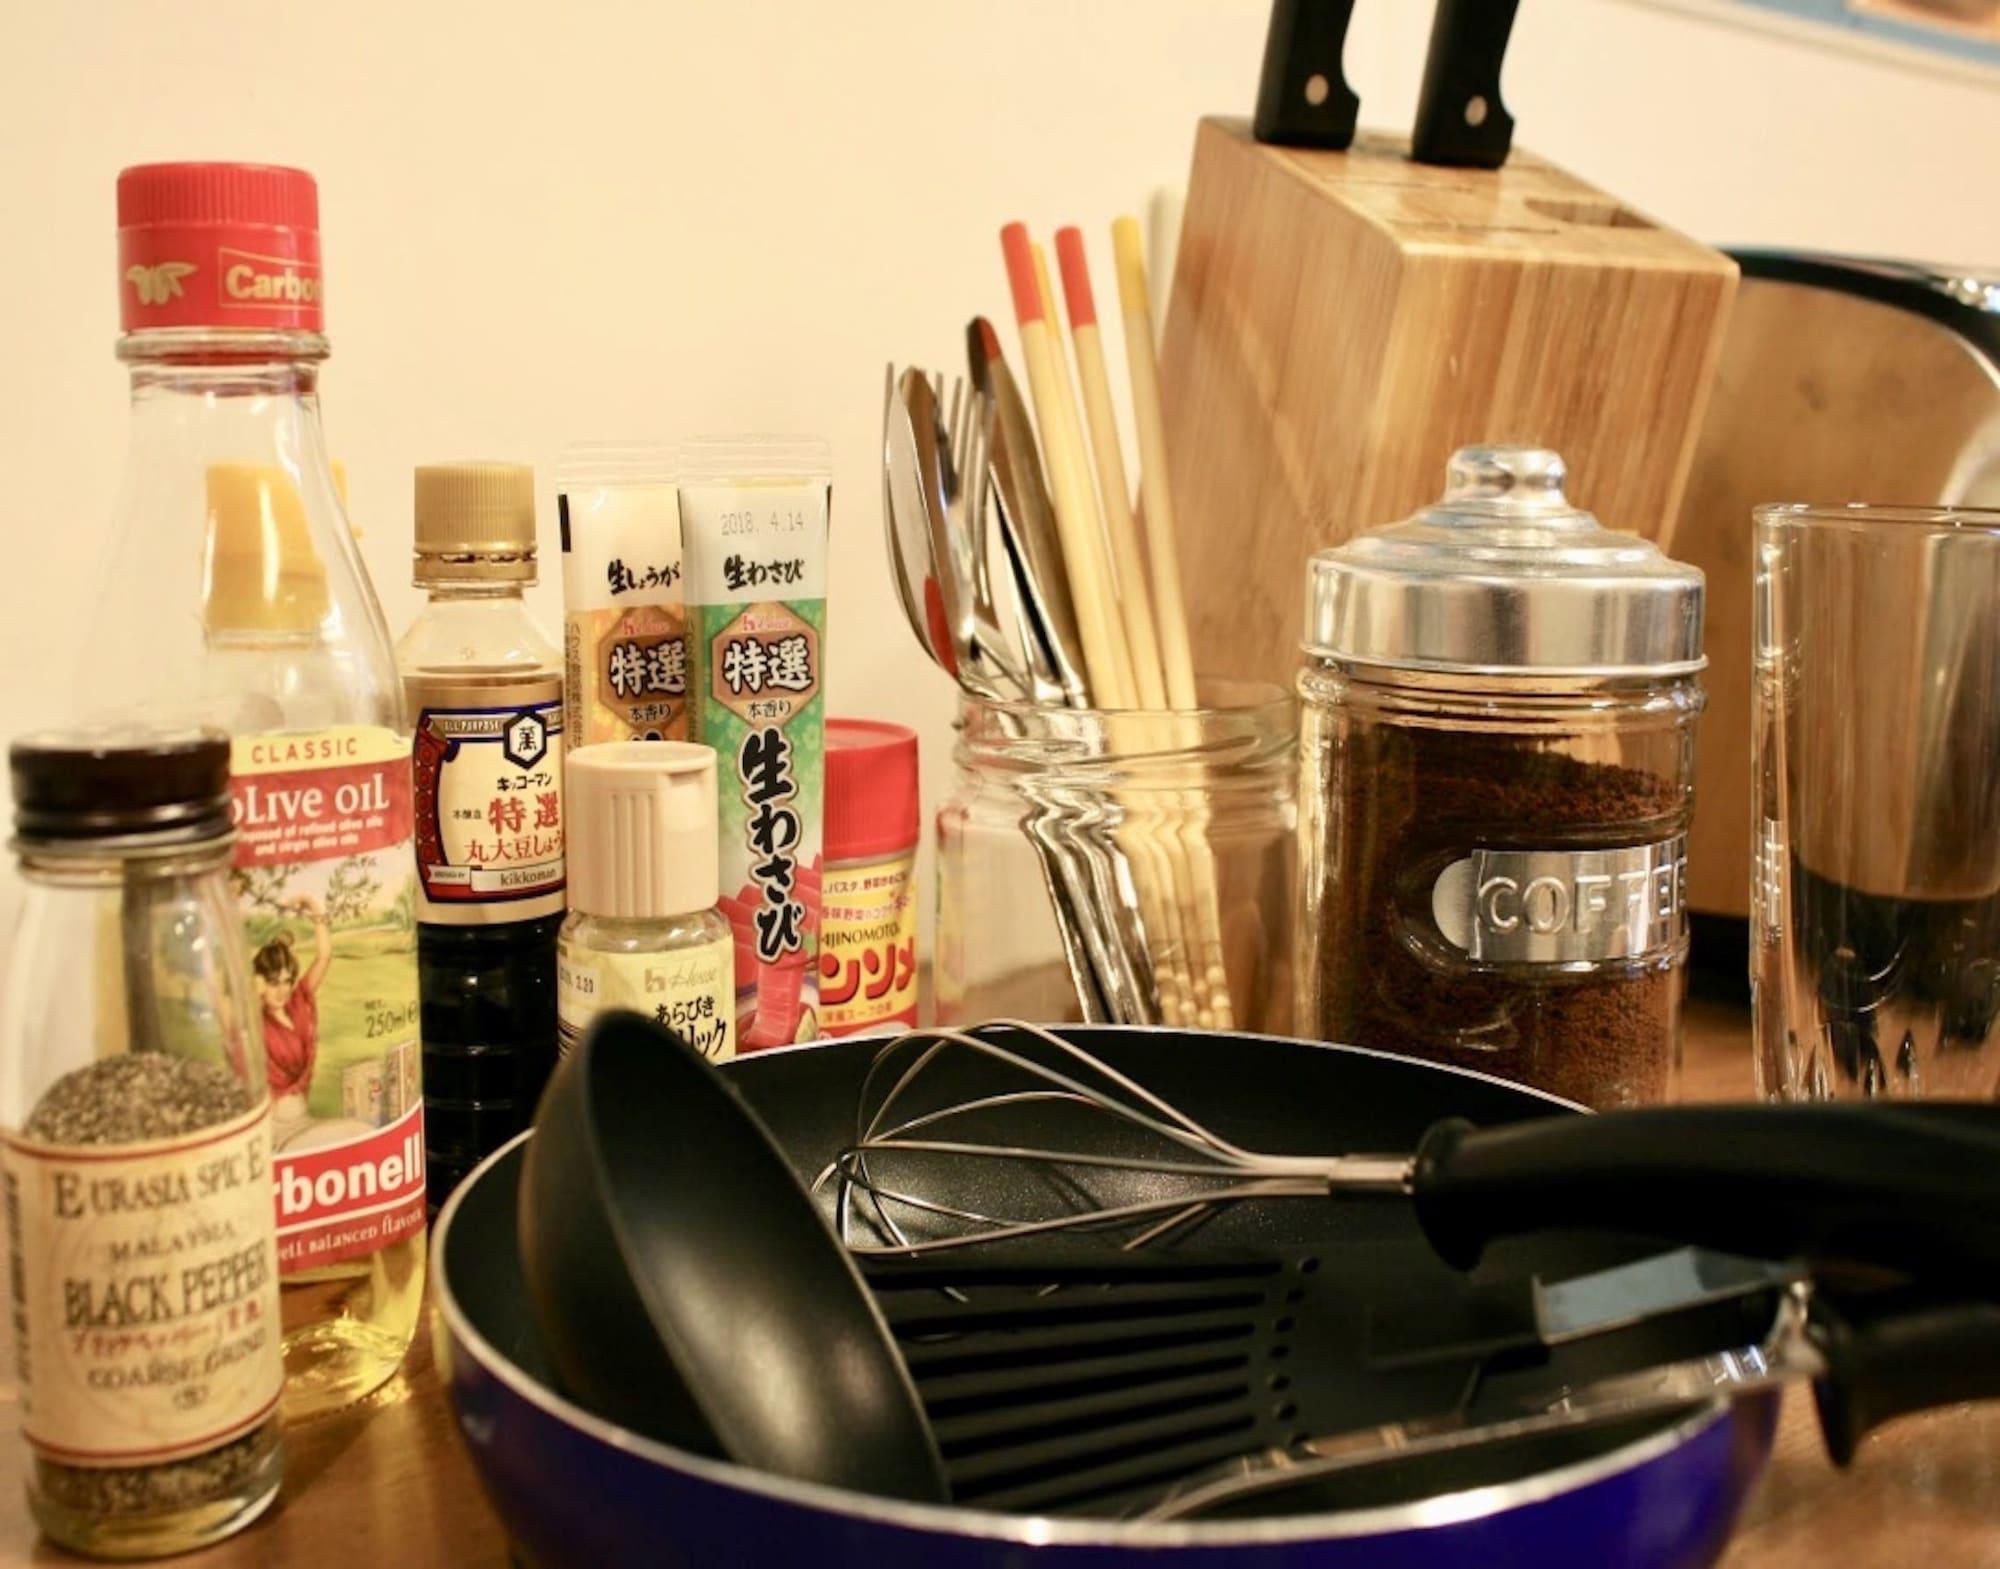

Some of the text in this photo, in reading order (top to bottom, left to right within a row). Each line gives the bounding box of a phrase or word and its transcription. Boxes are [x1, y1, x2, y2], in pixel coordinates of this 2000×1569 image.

[607, 558, 681, 596] 生しょうが
[723, 554, 805, 592] 生わさび
[609, 639, 687, 698] 特選
[723, 634, 814, 695] 特選
[629, 703, 671, 721] 本香り
[748, 699, 792, 719] 本香り
[252, 738, 357, 764] CLASSIC
[497, 773, 552, 791] キッコーマン
[488, 791, 559, 834] 特選
[740, 727, 802, 959] 生わさび
[500, 868, 557, 887] kikkoman
[820, 936, 916, 1006] ンソメ
[655, 995, 715, 1026] あらびき
[273, 1132, 421, 1215] bonell
[279, 1240, 303, 1260] ell
[64, 1275, 174, 1329] BLACK
[181, 1239, 271, 1317] PEPPER
